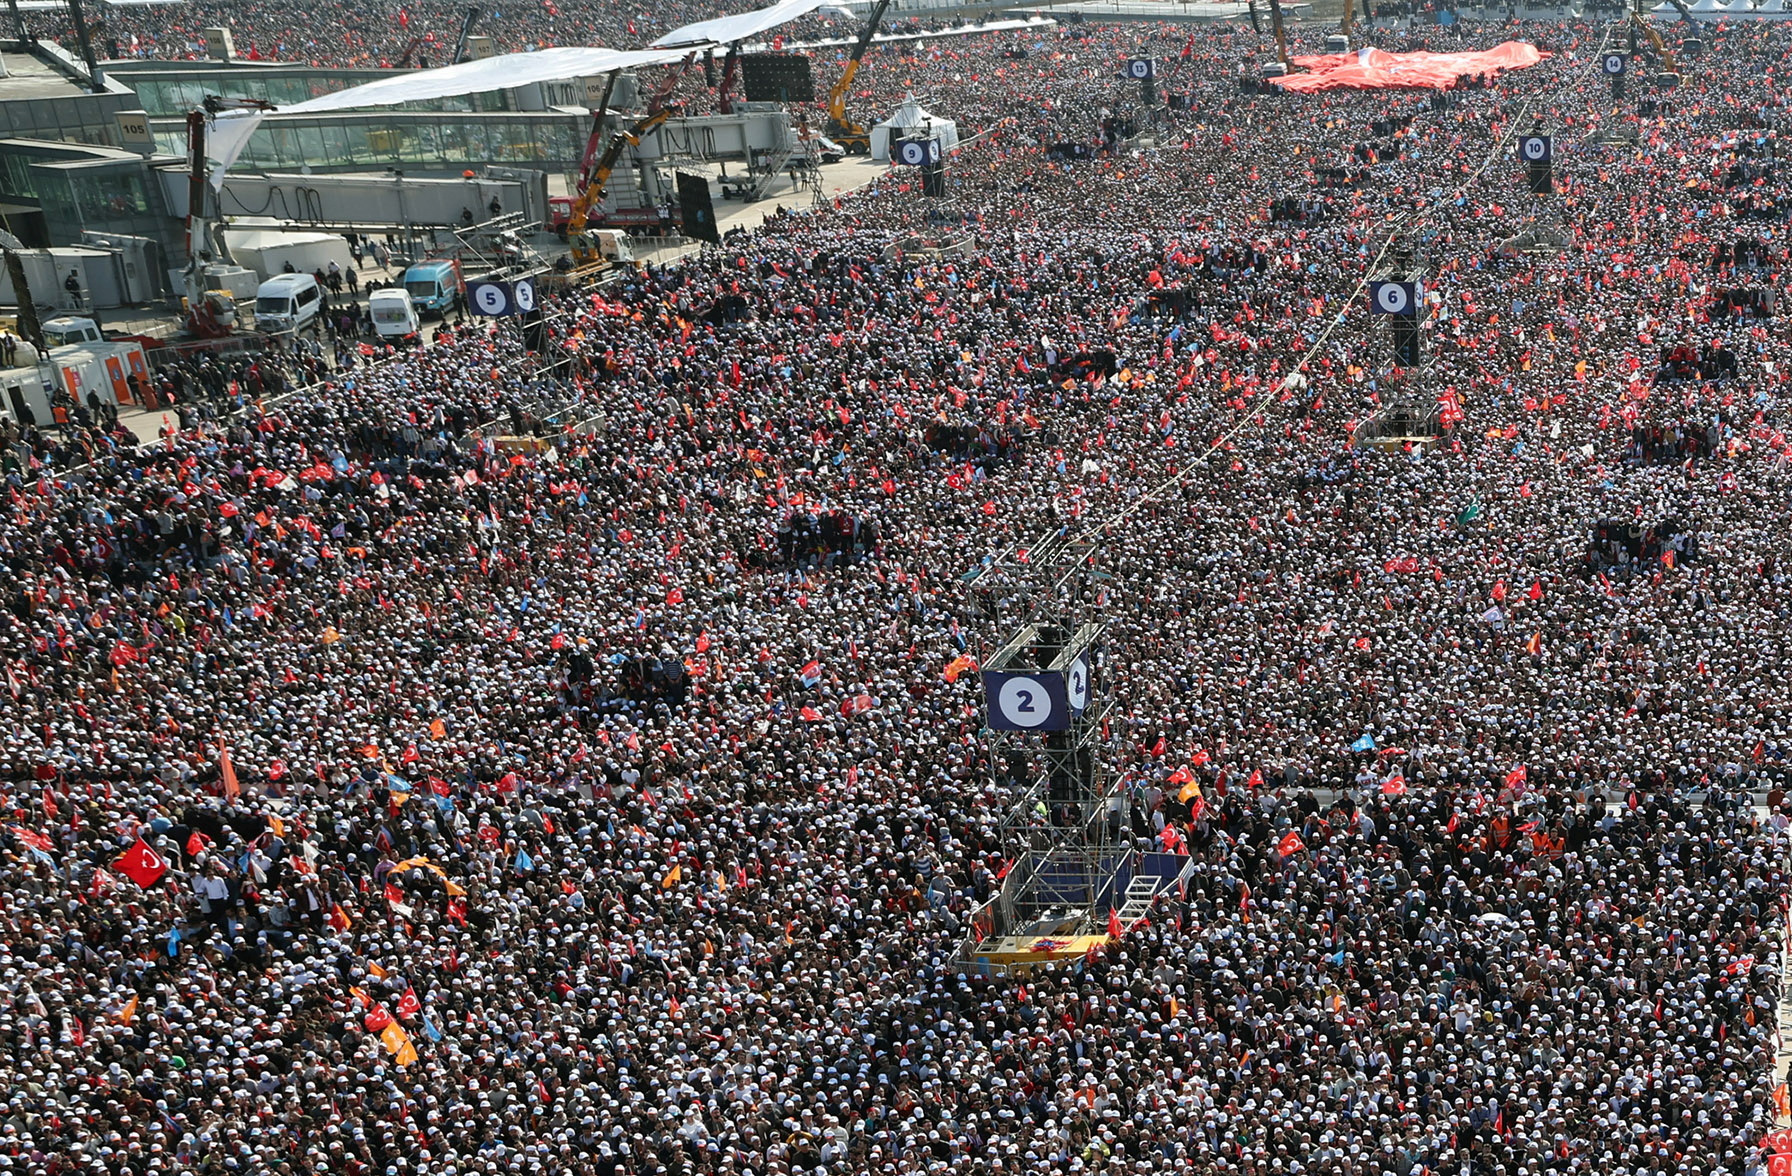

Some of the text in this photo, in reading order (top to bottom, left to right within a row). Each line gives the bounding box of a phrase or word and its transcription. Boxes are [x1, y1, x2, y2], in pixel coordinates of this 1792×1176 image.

[1135, 65, 1144, 73] 13
[1609, 60, 1618, 68] 14
[123, 124, 145, 135] 105
[1529, 143, 1541, 153] 10
[908, 149, 916, 159] 9
[486, 292, 497, 306] 5
[1387, 290, 1398, 304] 6
[1073, 670, 1085, 694] 2
[1016, 690, 1034, 713] 2
